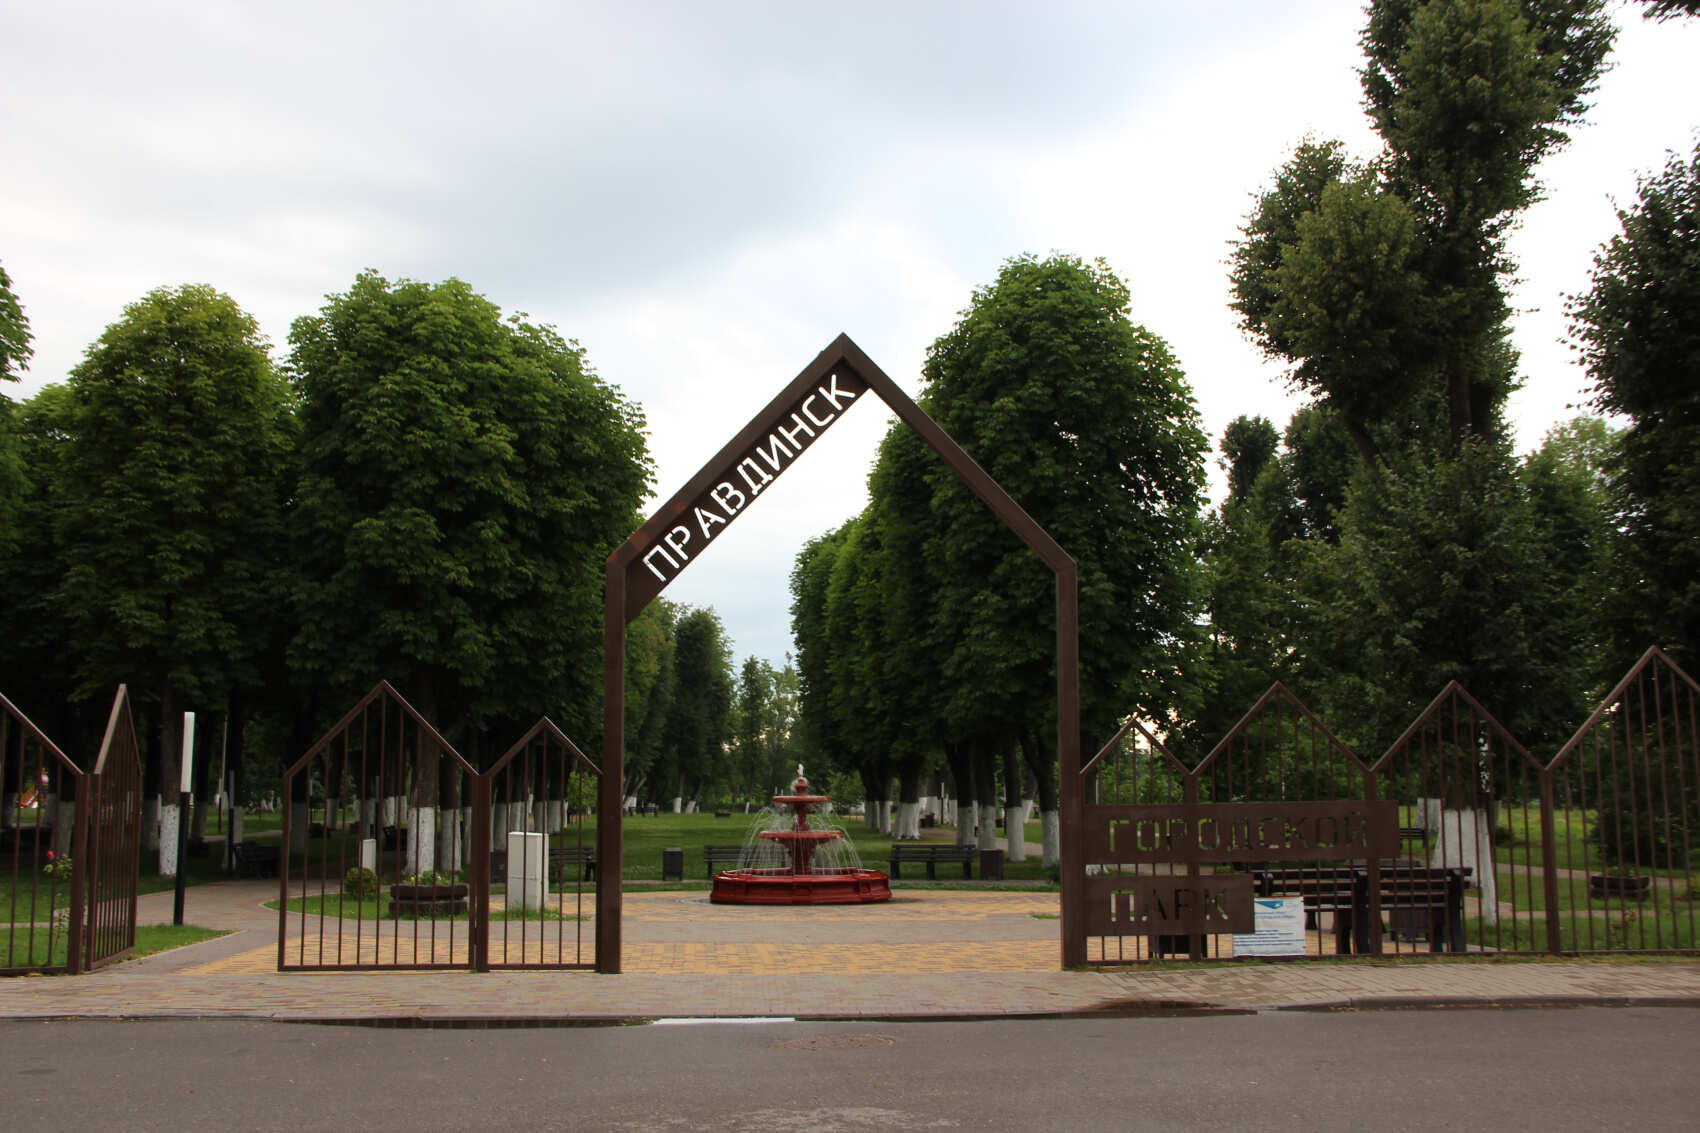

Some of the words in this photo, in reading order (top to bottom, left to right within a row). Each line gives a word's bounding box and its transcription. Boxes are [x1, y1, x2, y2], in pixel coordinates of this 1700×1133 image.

[642, 374, 856, 582] ПРАВДИНСК
[1109, 810, 1368, 852] ГОРОДСКОЙ
[1110, 888, 1231, 922] ПАРК
